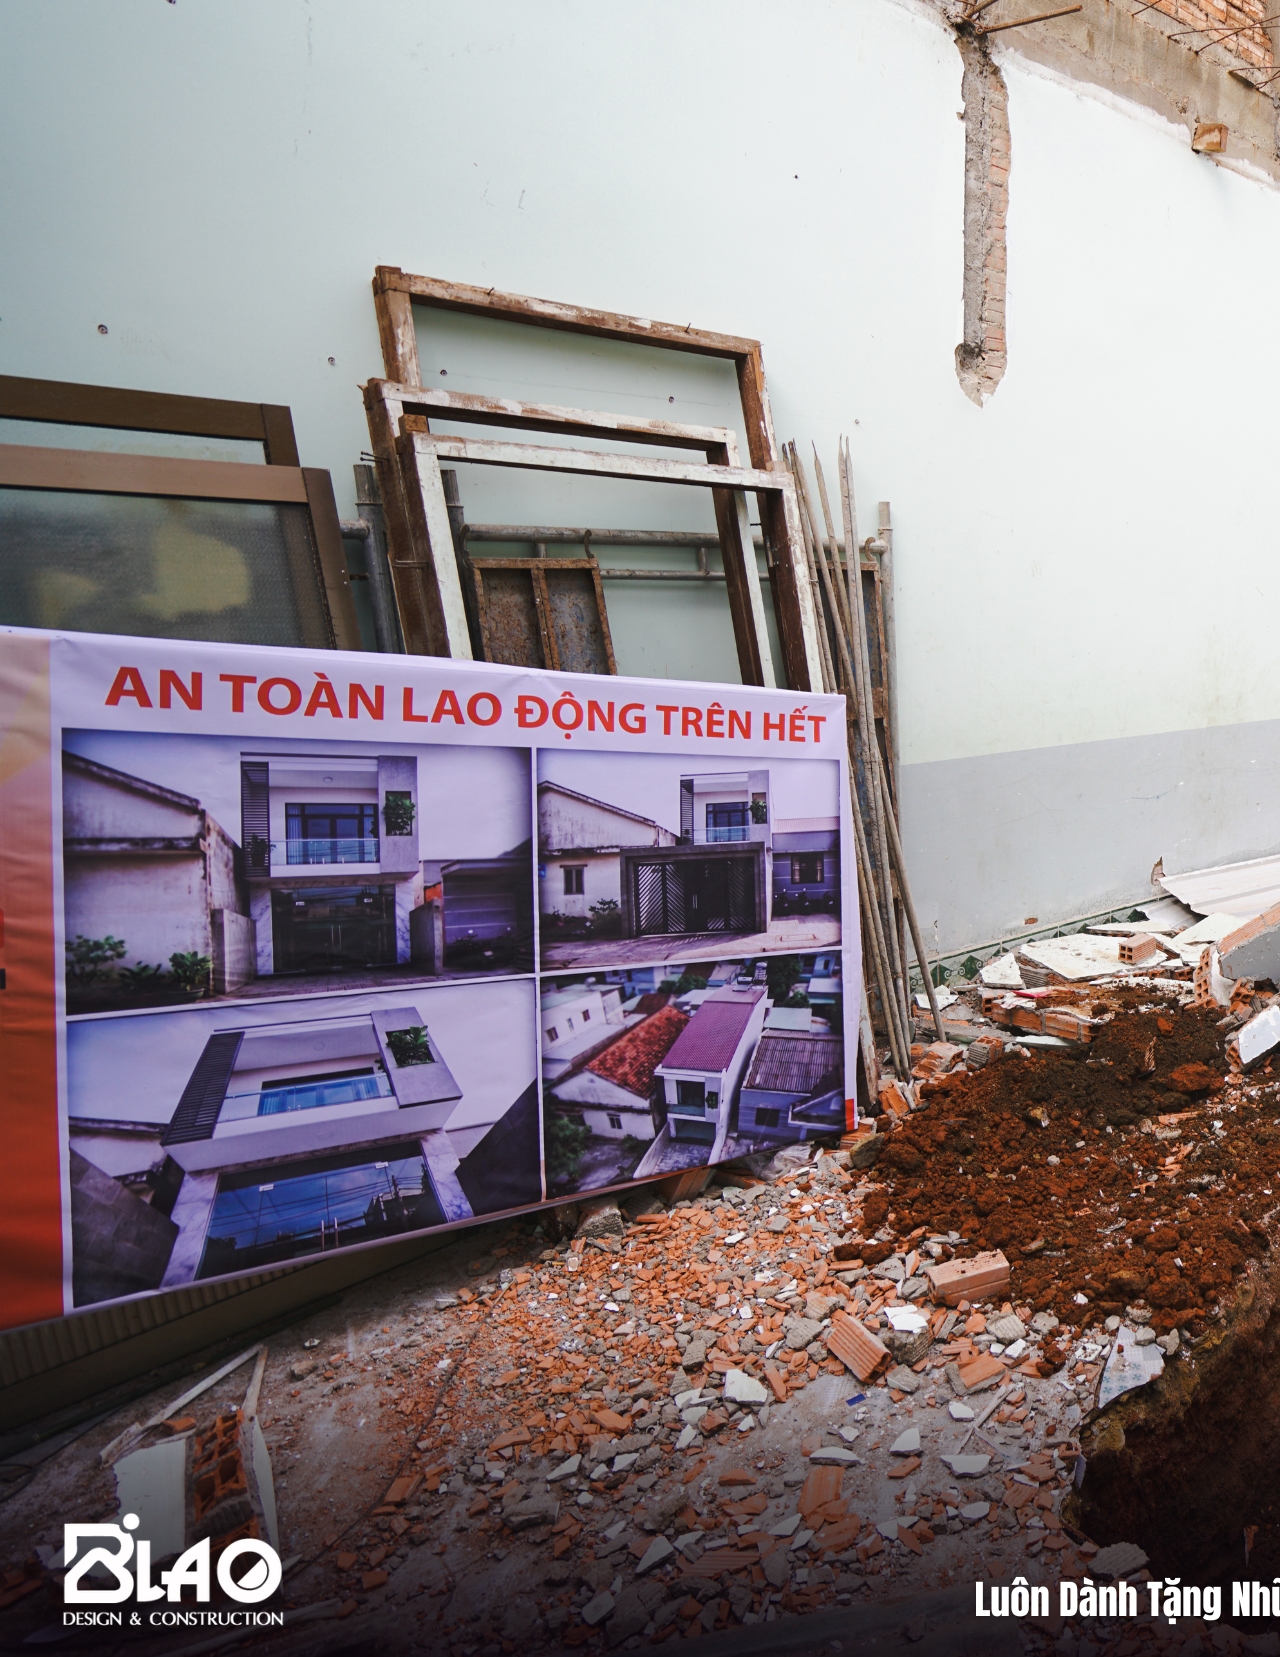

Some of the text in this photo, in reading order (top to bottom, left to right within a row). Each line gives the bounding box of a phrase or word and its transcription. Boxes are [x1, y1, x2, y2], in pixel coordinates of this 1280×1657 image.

[104, 666, 827, 743] AN TOÀN LAO ĐỘNG TRÊN HẾT
